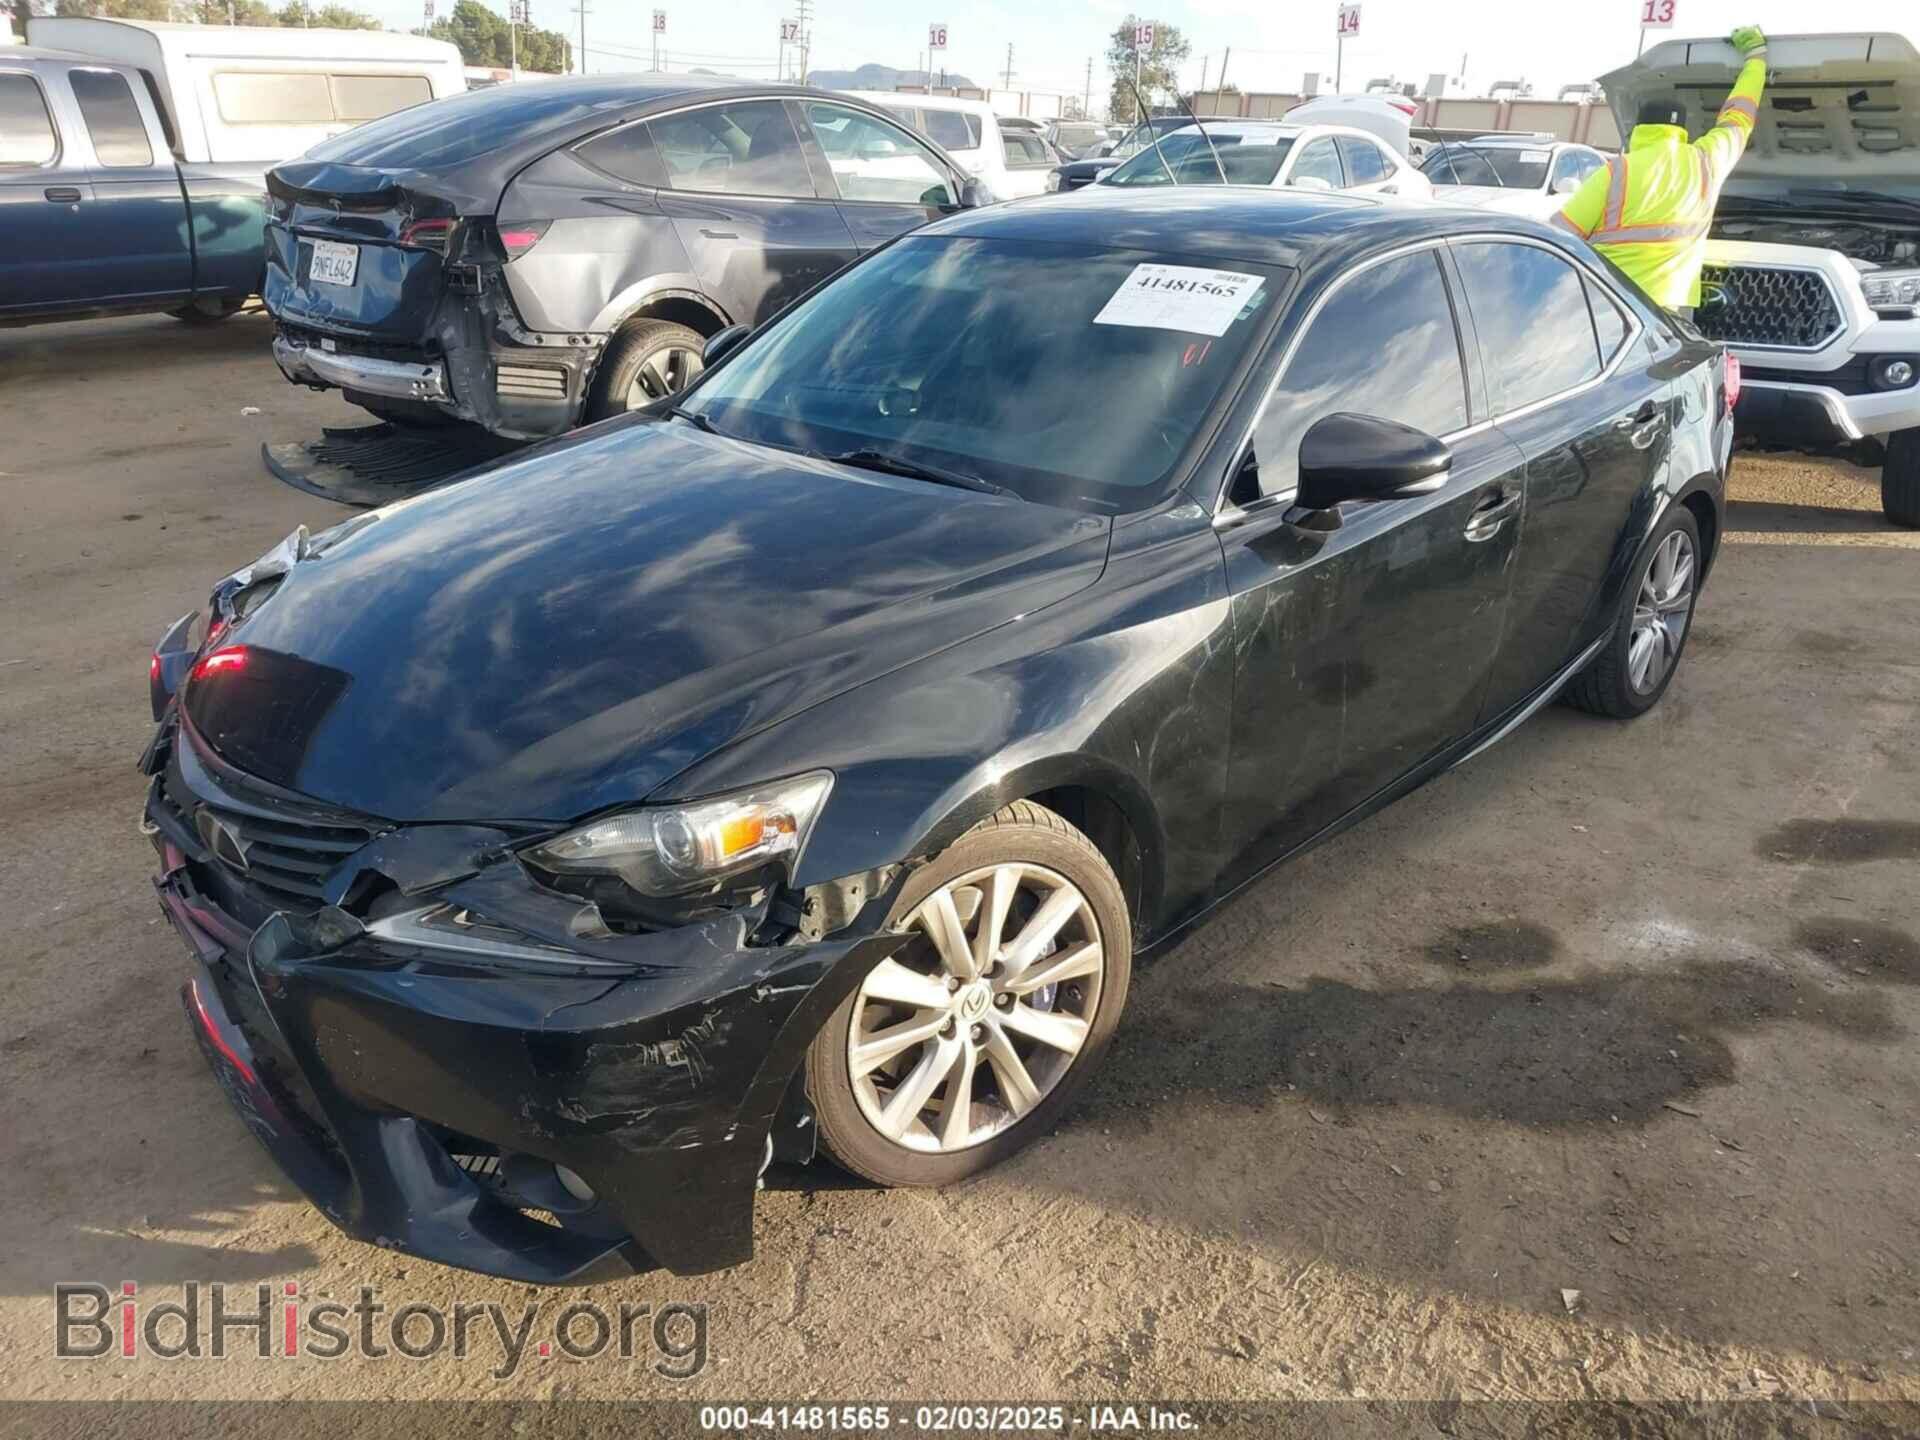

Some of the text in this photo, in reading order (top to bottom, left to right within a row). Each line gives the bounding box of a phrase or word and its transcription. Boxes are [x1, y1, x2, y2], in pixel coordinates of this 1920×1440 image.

[1641, 0, 1674, 22] 13
[653, 15, 665, 30] 18
[1338, 10, 1360, 32] 14
[780, 24, 798, 40] 17
[930, 29, 947, 46] 16
[1136, 25, 1153, 44] 15
[1137, 275, 1239, 298] 41481565
